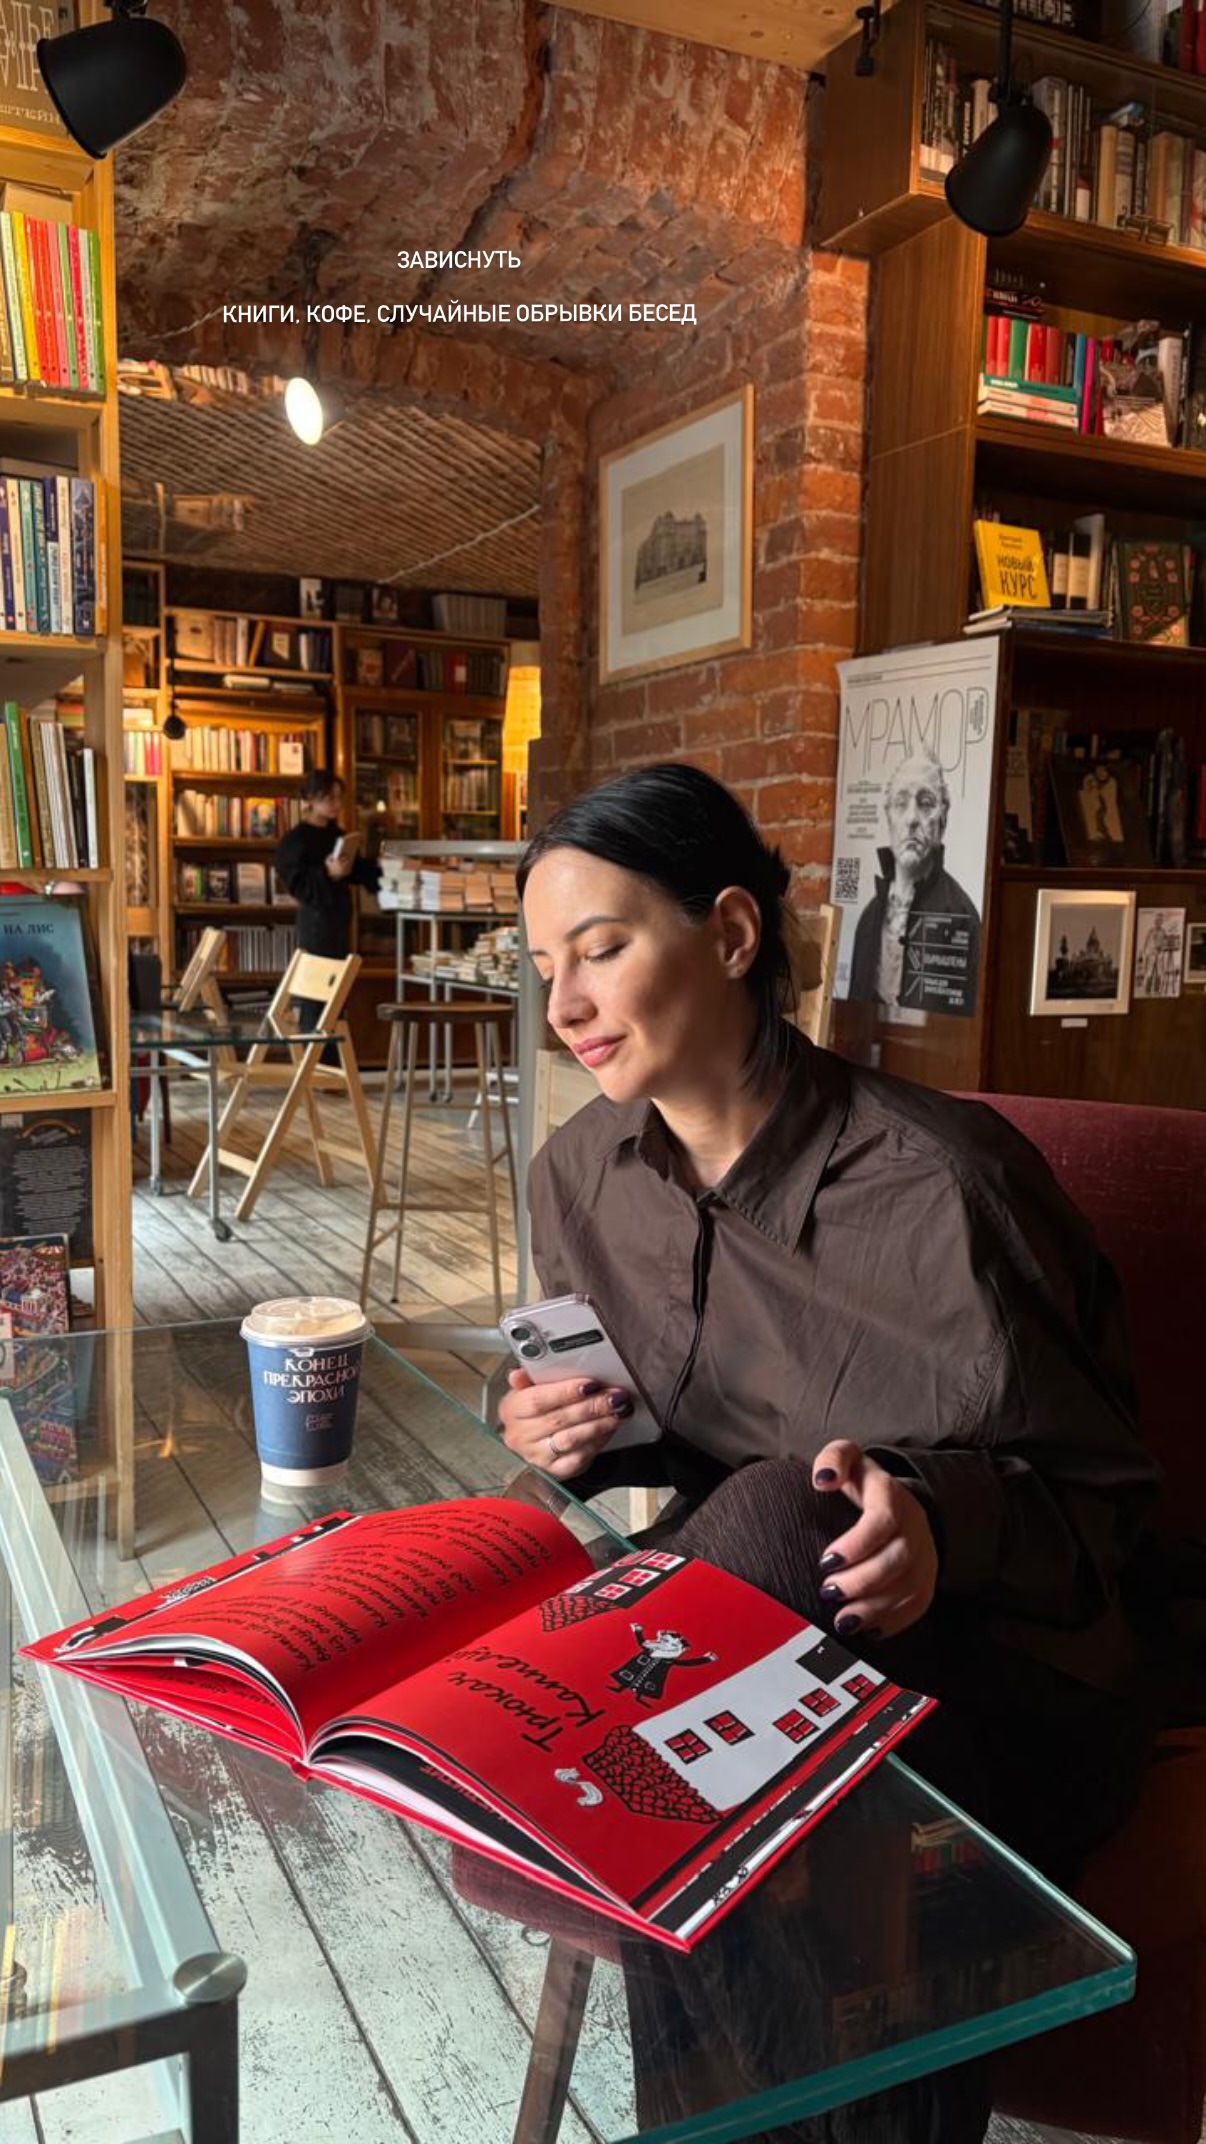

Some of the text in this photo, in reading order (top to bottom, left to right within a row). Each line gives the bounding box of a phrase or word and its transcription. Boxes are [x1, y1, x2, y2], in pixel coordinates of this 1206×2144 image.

[1000, 570, 1037, 600] КУРС
[841, 686, 990, 801] МРАМОР
[284, 1353, 348, 1372] КОНЕЦ
[287, 1385, 345, 1404] ЭПОХИ
[448, 1671, 563, 1753] Трюкач
